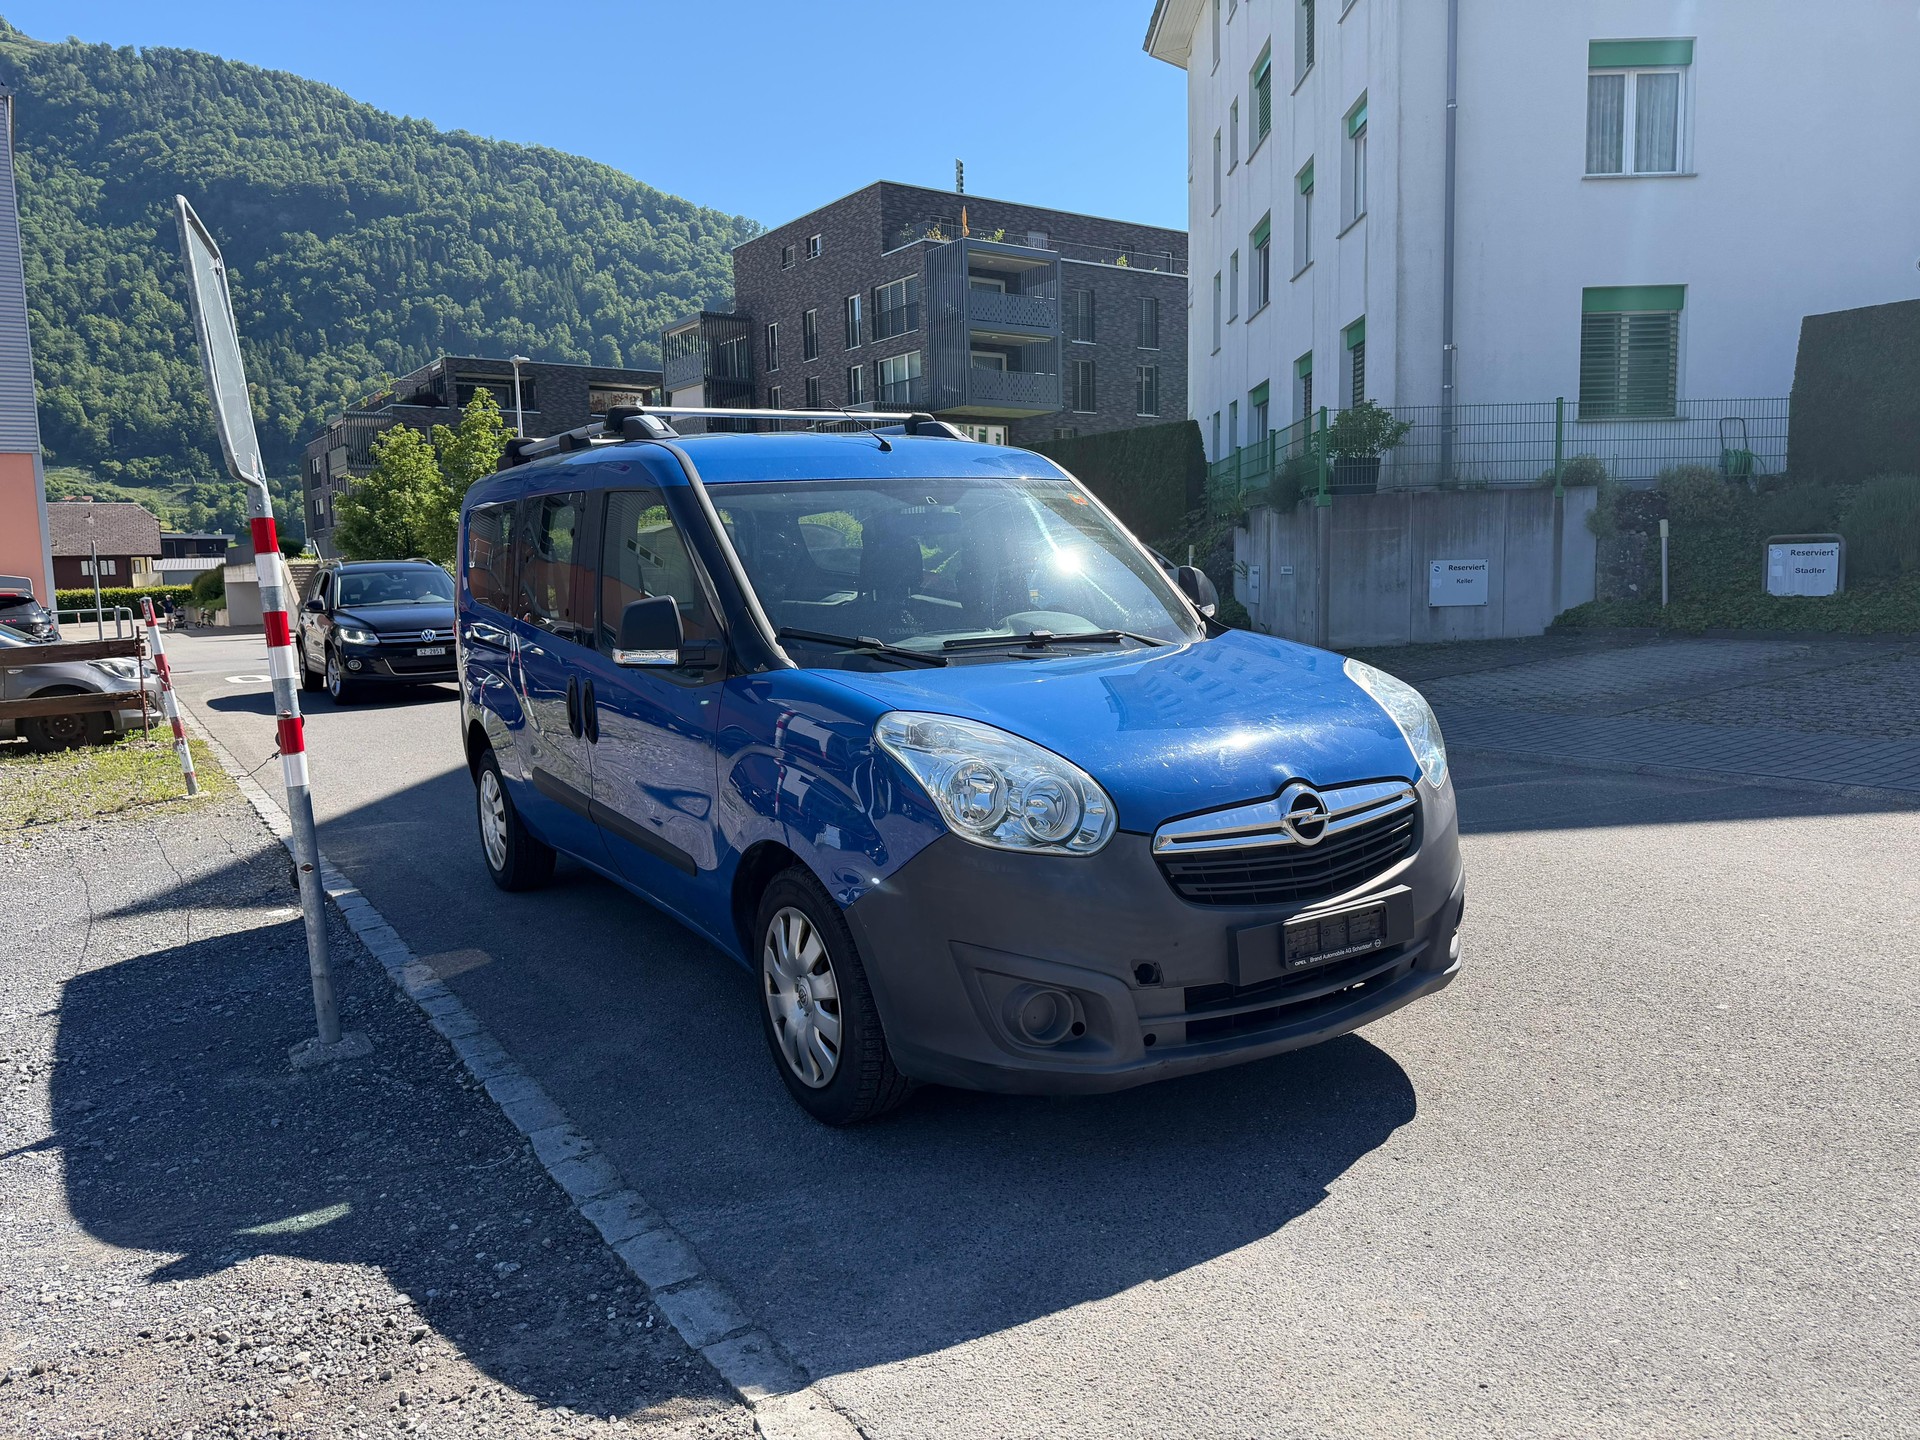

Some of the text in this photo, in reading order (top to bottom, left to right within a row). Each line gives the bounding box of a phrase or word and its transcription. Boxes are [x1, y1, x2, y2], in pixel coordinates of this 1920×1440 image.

[1790, 548, 1835, 556] Reserviert
[888, 627, 924, 635] COMBO
[1309, 954, 1323, 963] Brand
[1322, 949, 1345, 960] Automobile
